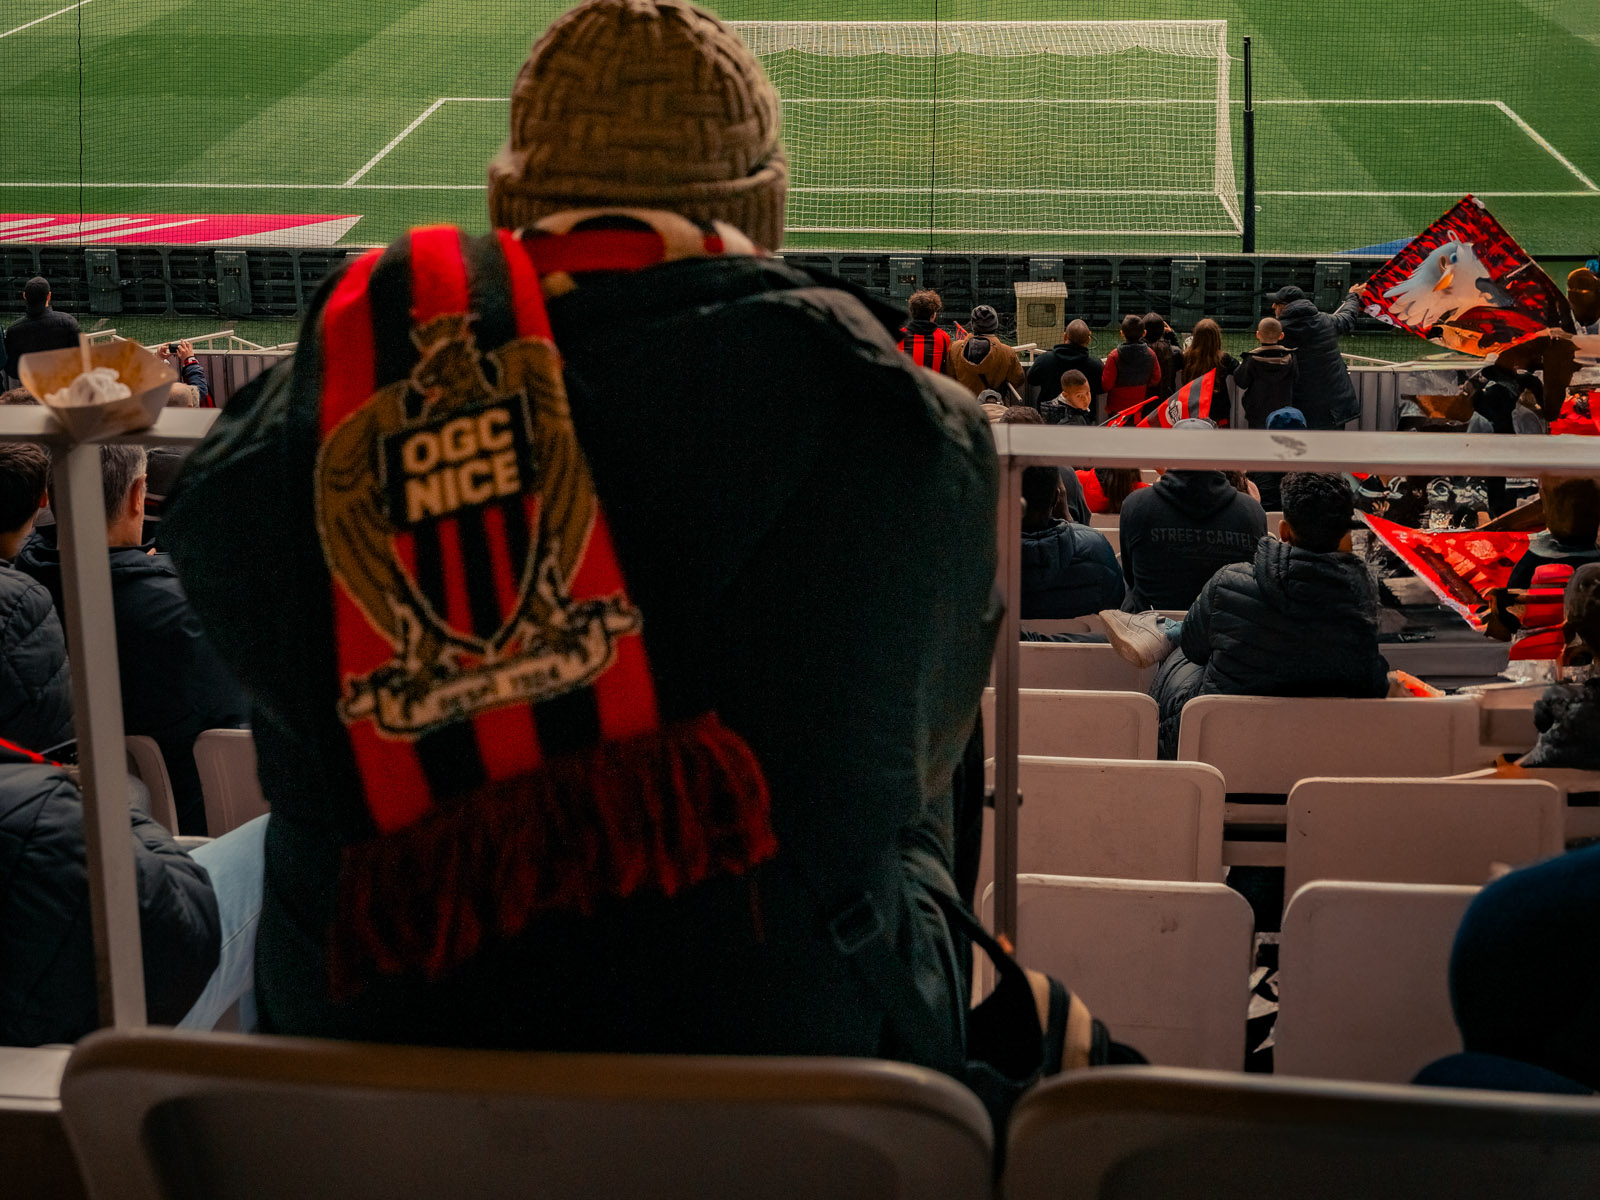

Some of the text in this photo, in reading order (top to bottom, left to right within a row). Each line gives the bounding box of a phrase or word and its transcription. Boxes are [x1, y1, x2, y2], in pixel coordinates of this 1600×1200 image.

[402, 407, 514, 474] OGC
[406, 450, 522, 523] NICE
[1150, 527, 1254, 549] STREET CARTEL
